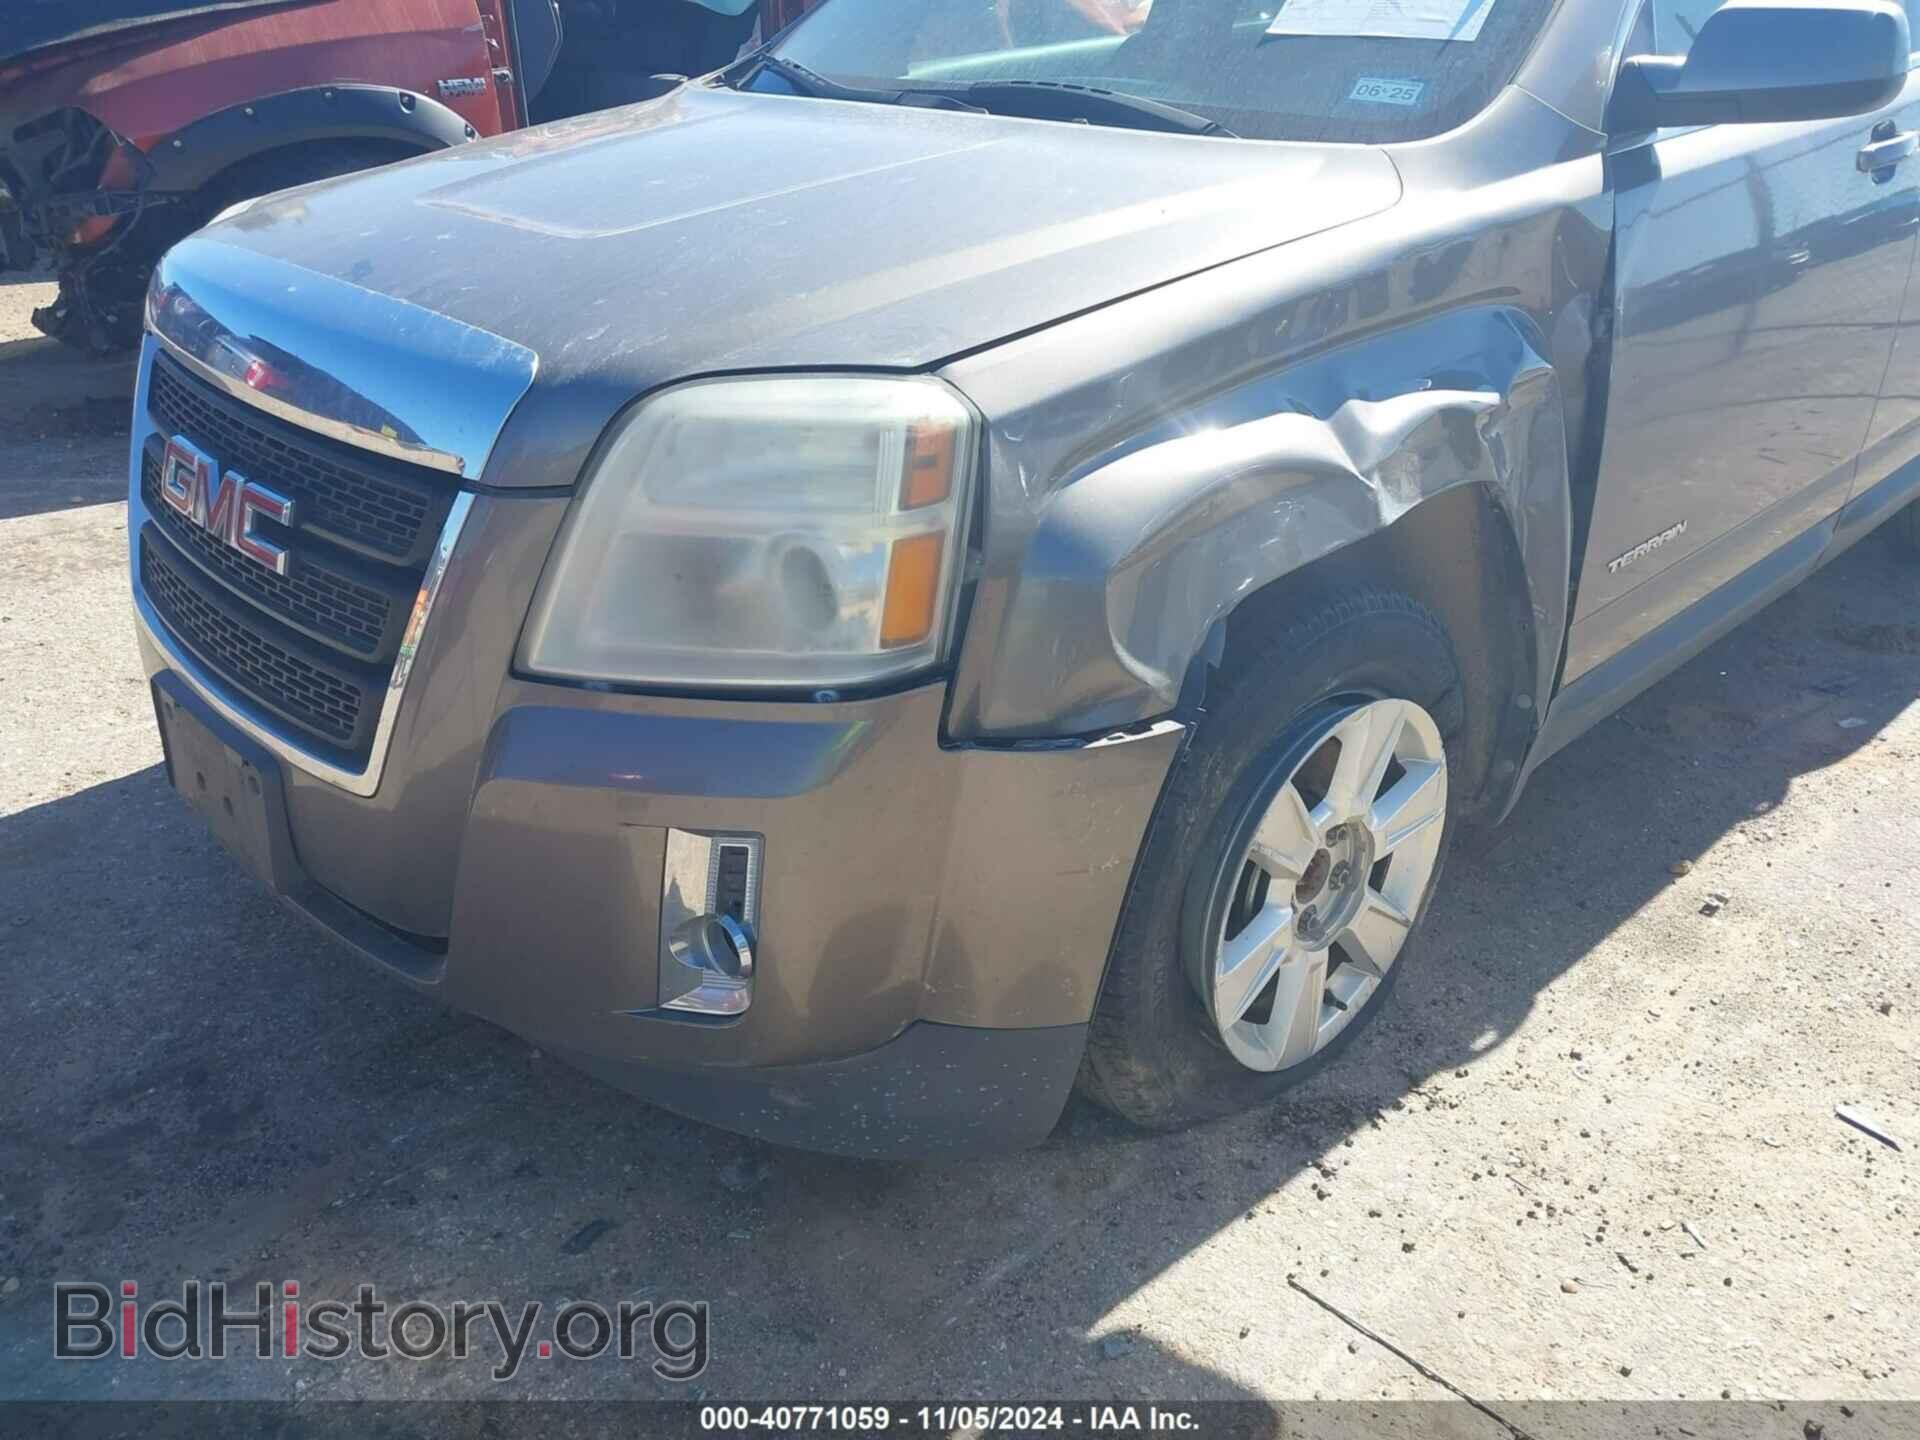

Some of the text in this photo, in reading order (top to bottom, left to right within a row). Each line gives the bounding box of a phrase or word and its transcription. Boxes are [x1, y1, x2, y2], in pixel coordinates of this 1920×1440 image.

[437, 77, 486, 95] HEMI
[161, 434, 296, 576] GMC
[1607, 519, 1688, 574] TERRAIN
